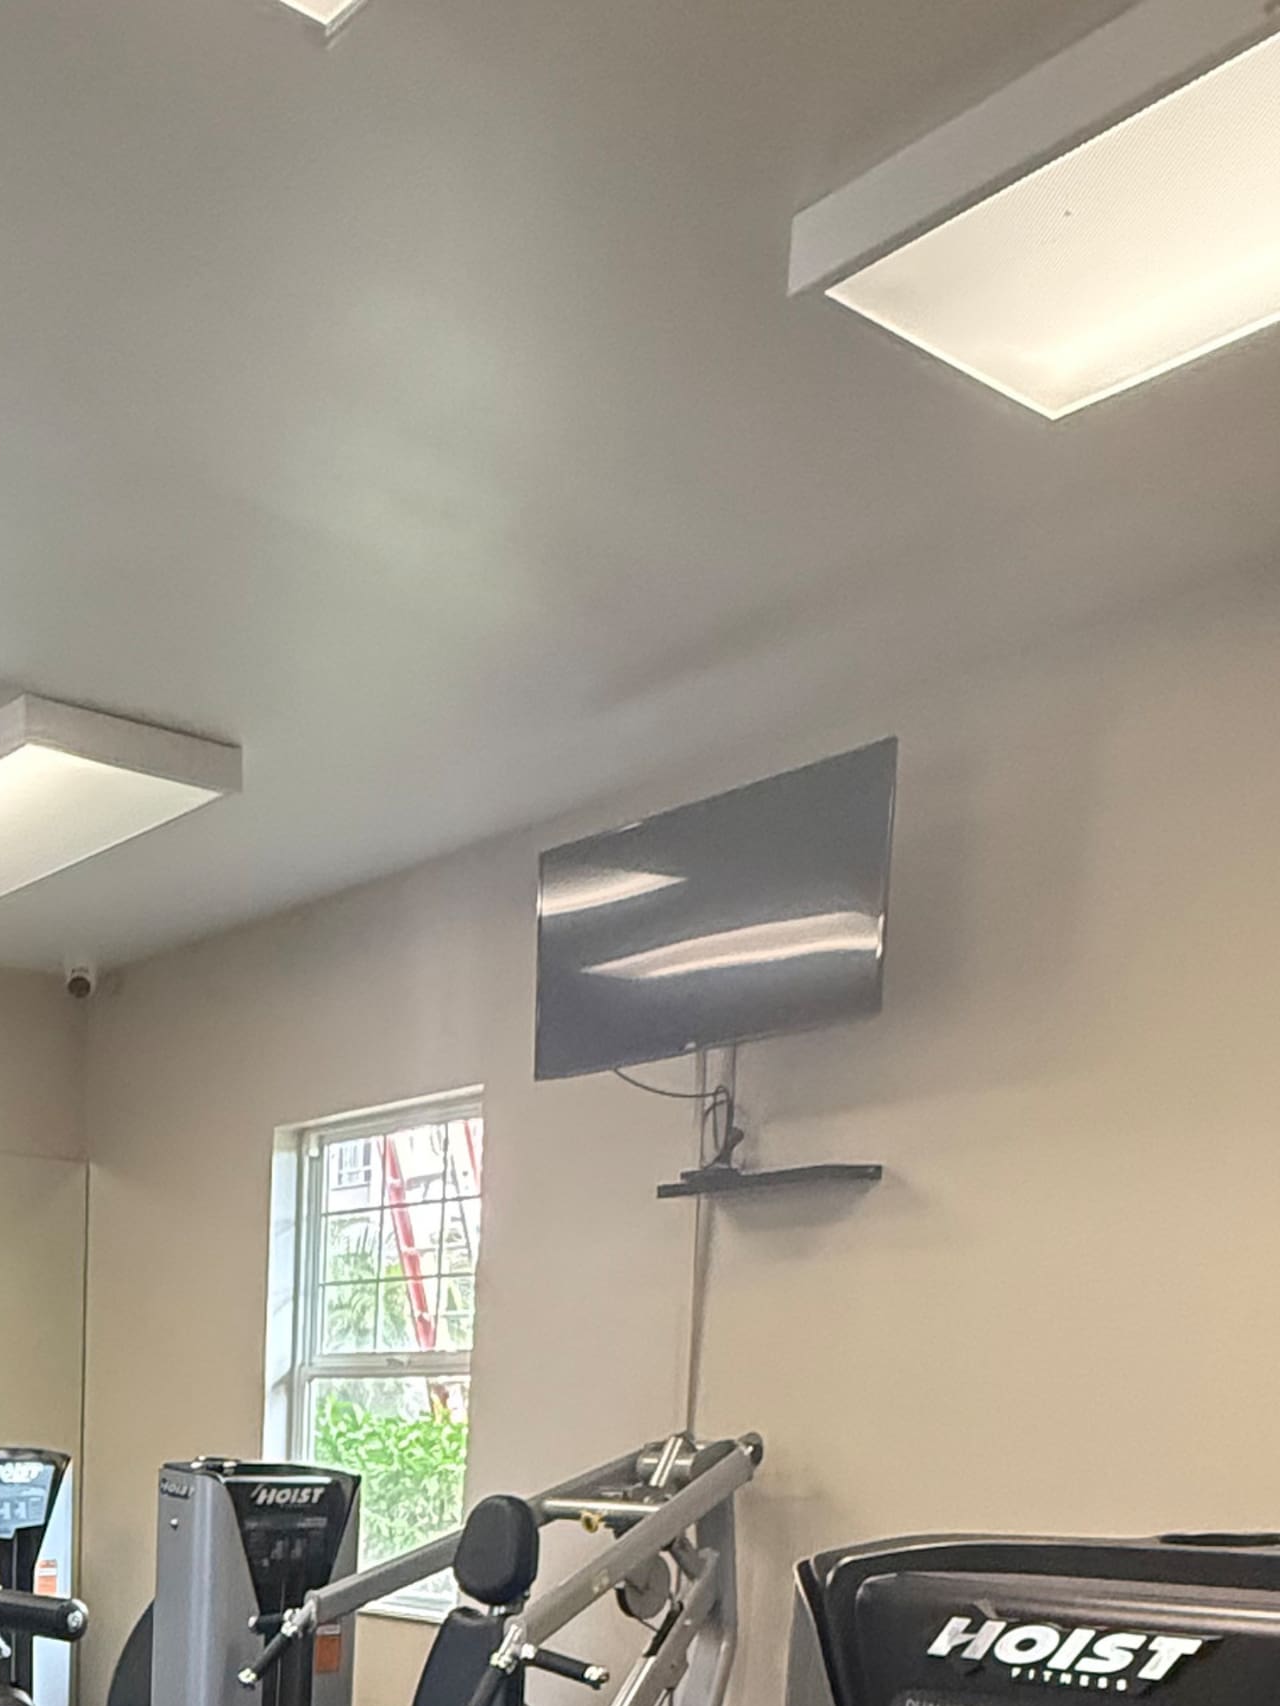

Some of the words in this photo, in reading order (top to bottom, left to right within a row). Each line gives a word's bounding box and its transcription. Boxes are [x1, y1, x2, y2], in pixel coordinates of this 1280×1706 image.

[255, 1487, 326, 1506] HOIST
[926, 1616, 1204, 1681] HOIST
[1011, 1667, 1127, 1691] FITNESS
